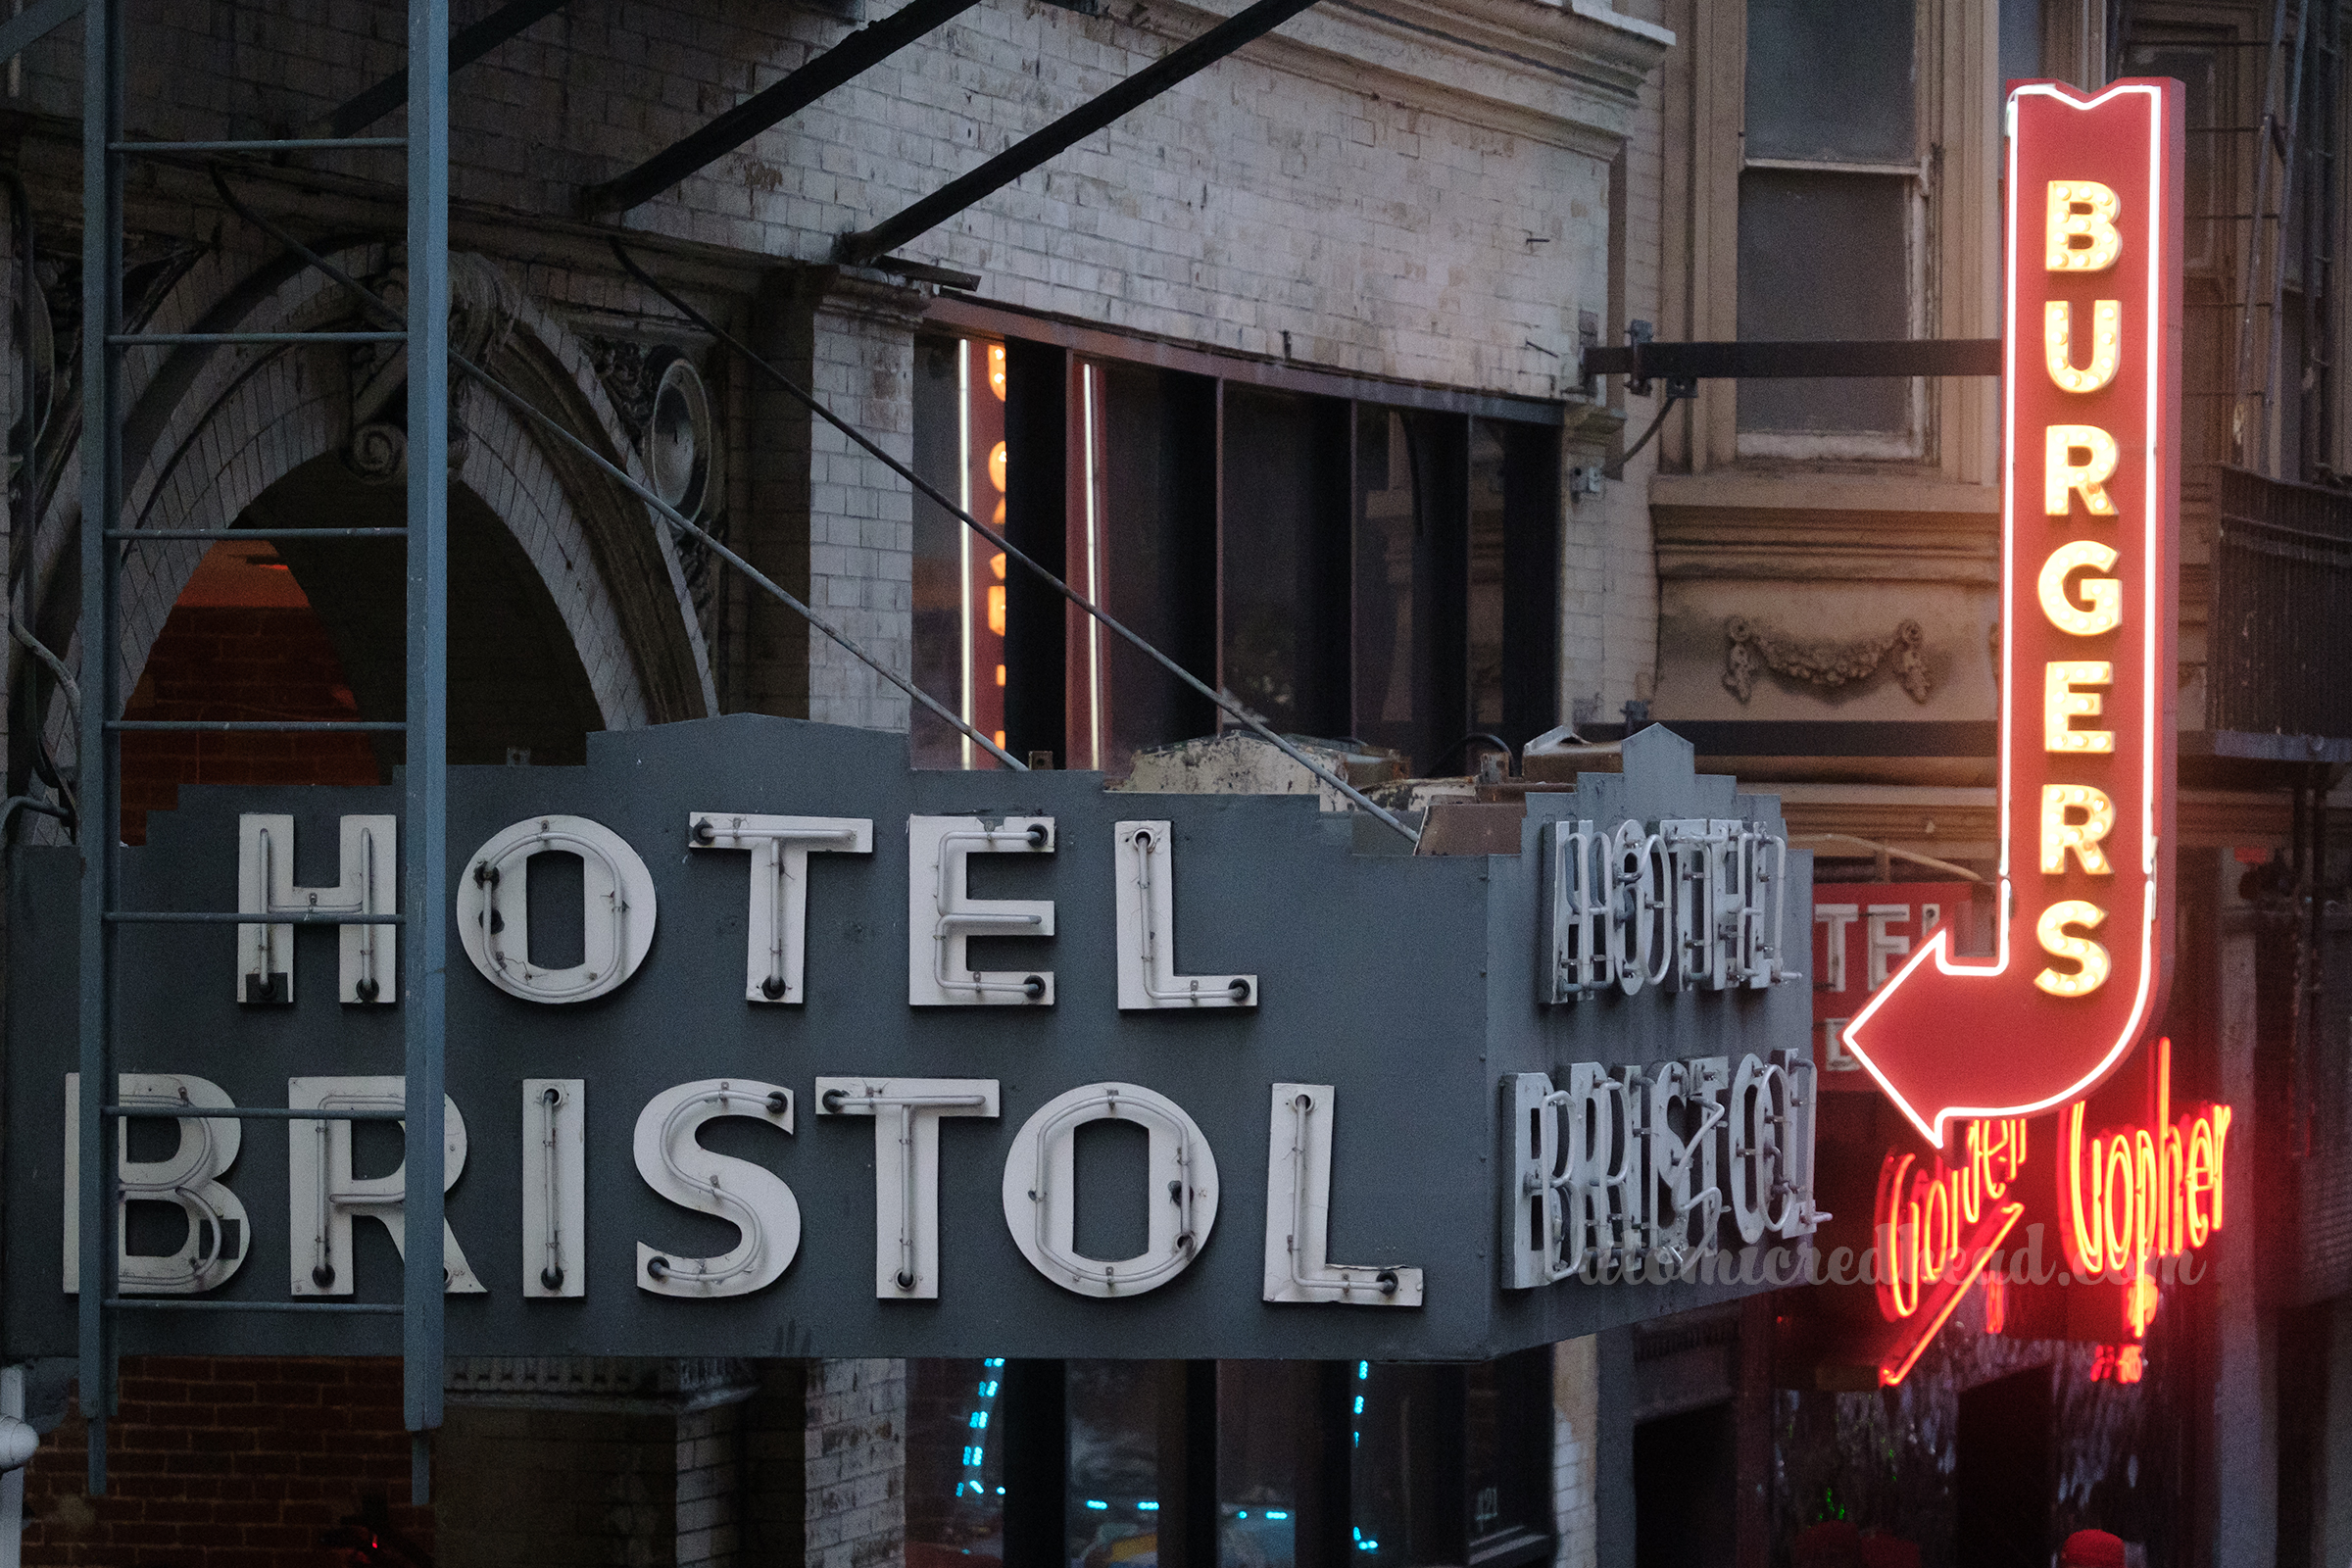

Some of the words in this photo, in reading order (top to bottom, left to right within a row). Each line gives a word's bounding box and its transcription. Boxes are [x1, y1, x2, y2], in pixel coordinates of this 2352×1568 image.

[2034, 179, 2124, 999] BURGERS
[236, 811, 1258, 1010] HOTEL
[63, 1073, 1424, 1306] BRISTOL
